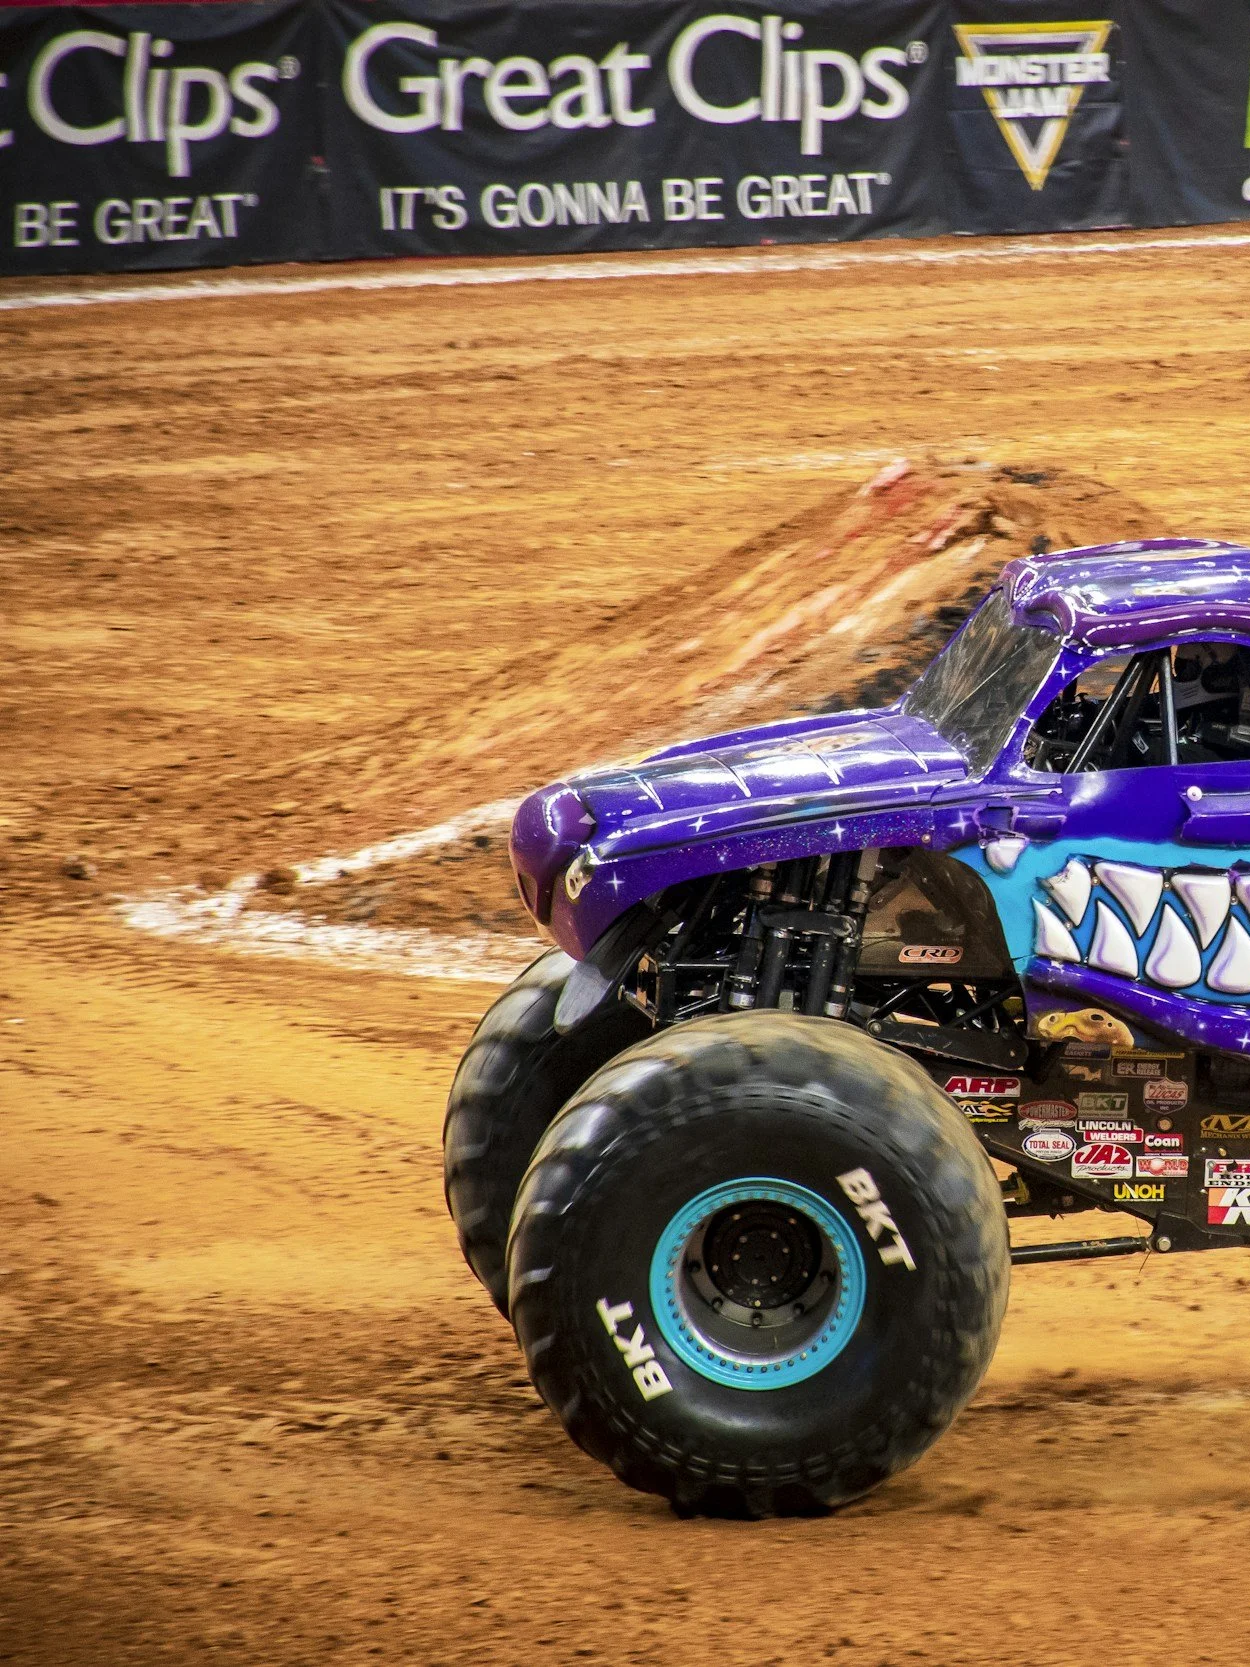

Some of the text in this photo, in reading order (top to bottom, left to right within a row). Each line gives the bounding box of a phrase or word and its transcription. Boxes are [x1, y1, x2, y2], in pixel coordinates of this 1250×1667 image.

[343, 22, 654, 133] Great
[956, 52, 1110, 86] MONSTER
[998, 87, 1071, 118] JAM
[380, 173, 876, 231] IT'S GONNA BE GREAT
[14, 194, 242, 248] BE GREAT
[903, 948, 960, 958] CRD
[944, 1078, 1018, 1093] ARP
[1079, 1121, 1132, 1131] LINCOLN
[1029, 1140, 1070, 1150] TOTAL SEAL
[1090, 1132, 1137, 1141] WELDERS
[1145, 1135, 1180, 1147] Coan
[1074, 1145, 1131, 1164] JAZ
[1113, 1182, 1164, 1199] UNOH
[835, 1168, 917, 1271] BKT
[596, 1297, 673, 1401] BKT
